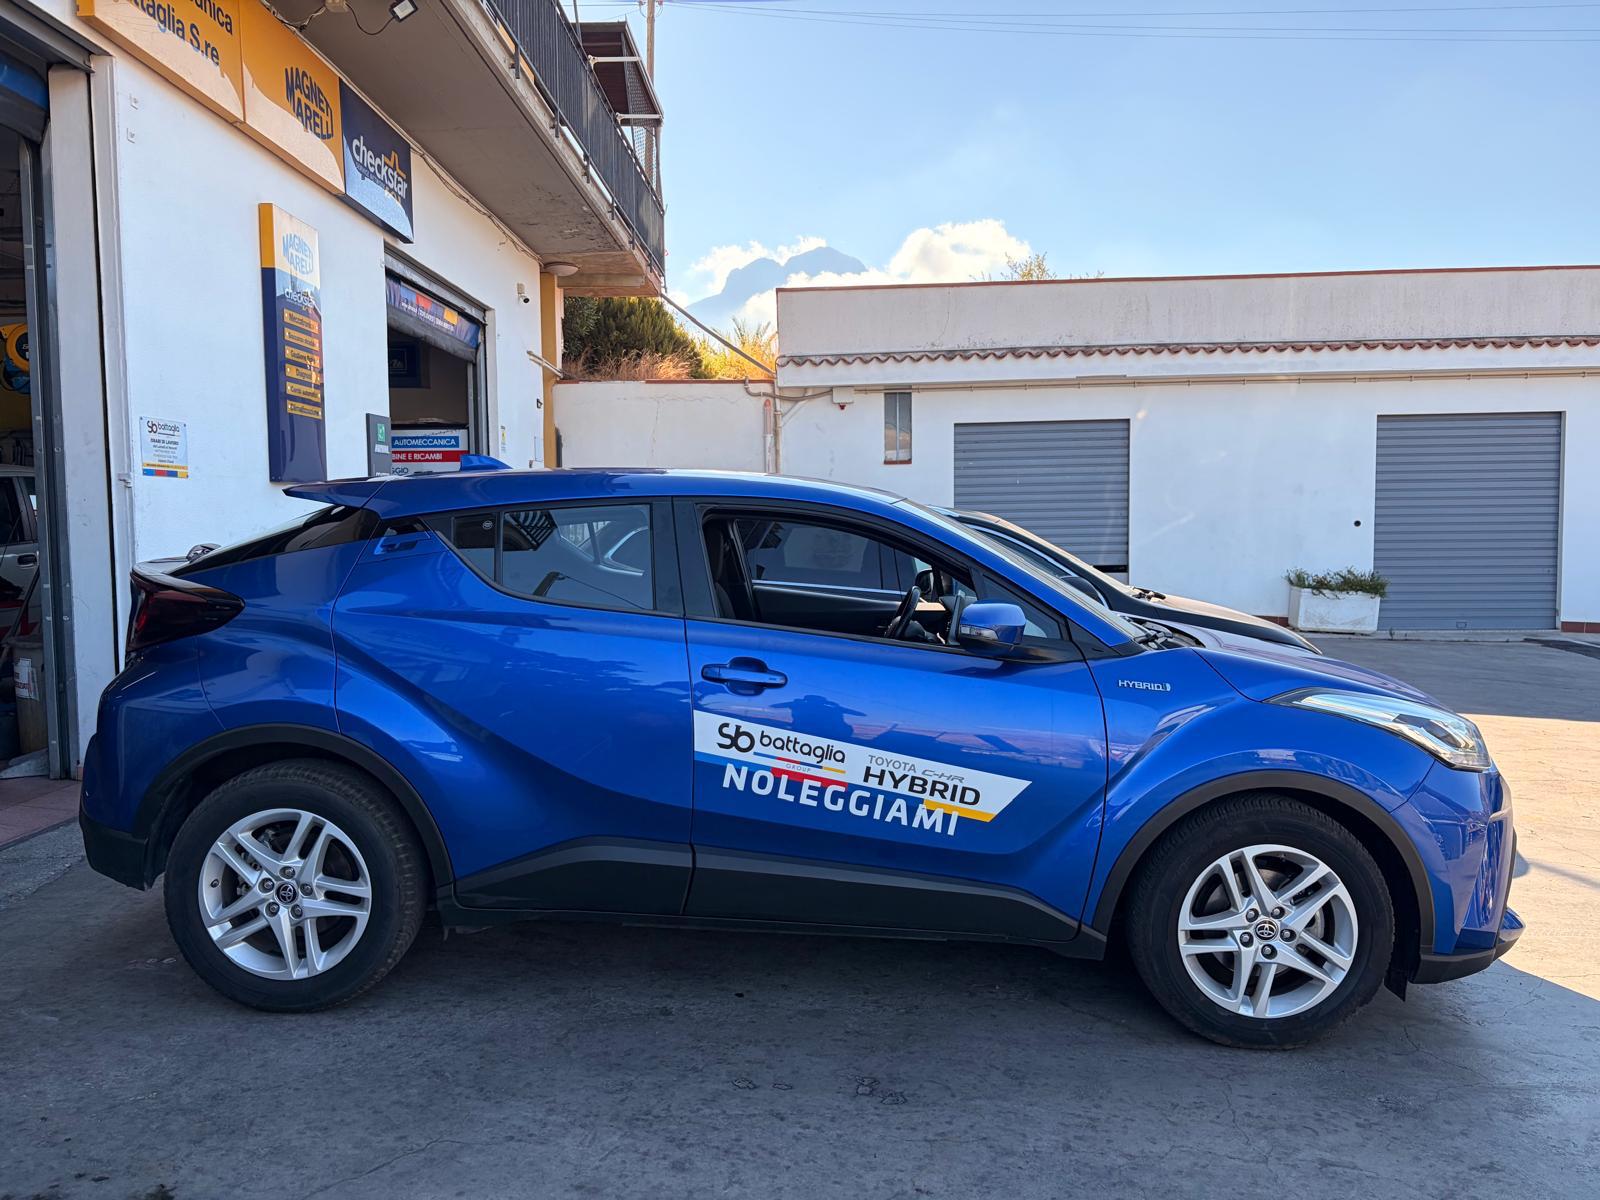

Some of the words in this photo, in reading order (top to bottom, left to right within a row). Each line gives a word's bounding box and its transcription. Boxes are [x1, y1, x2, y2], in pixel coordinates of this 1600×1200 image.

[352, 135, 408, 200] checkstar
[394, 438, 456, 446] AUTOMECCANICA
[1118, 679, 1162, 691] HYBRID
[716, 722, 756, 753] Sb
[759, 730, 847, 765] battaglia
[863, 765, 981, 807] HYBRID
[868, 754, 917, 774] TOYOTA
[921, 768, 965, 784] C-HR
[722, 763, 960, 837] NOLEGGIAMI
